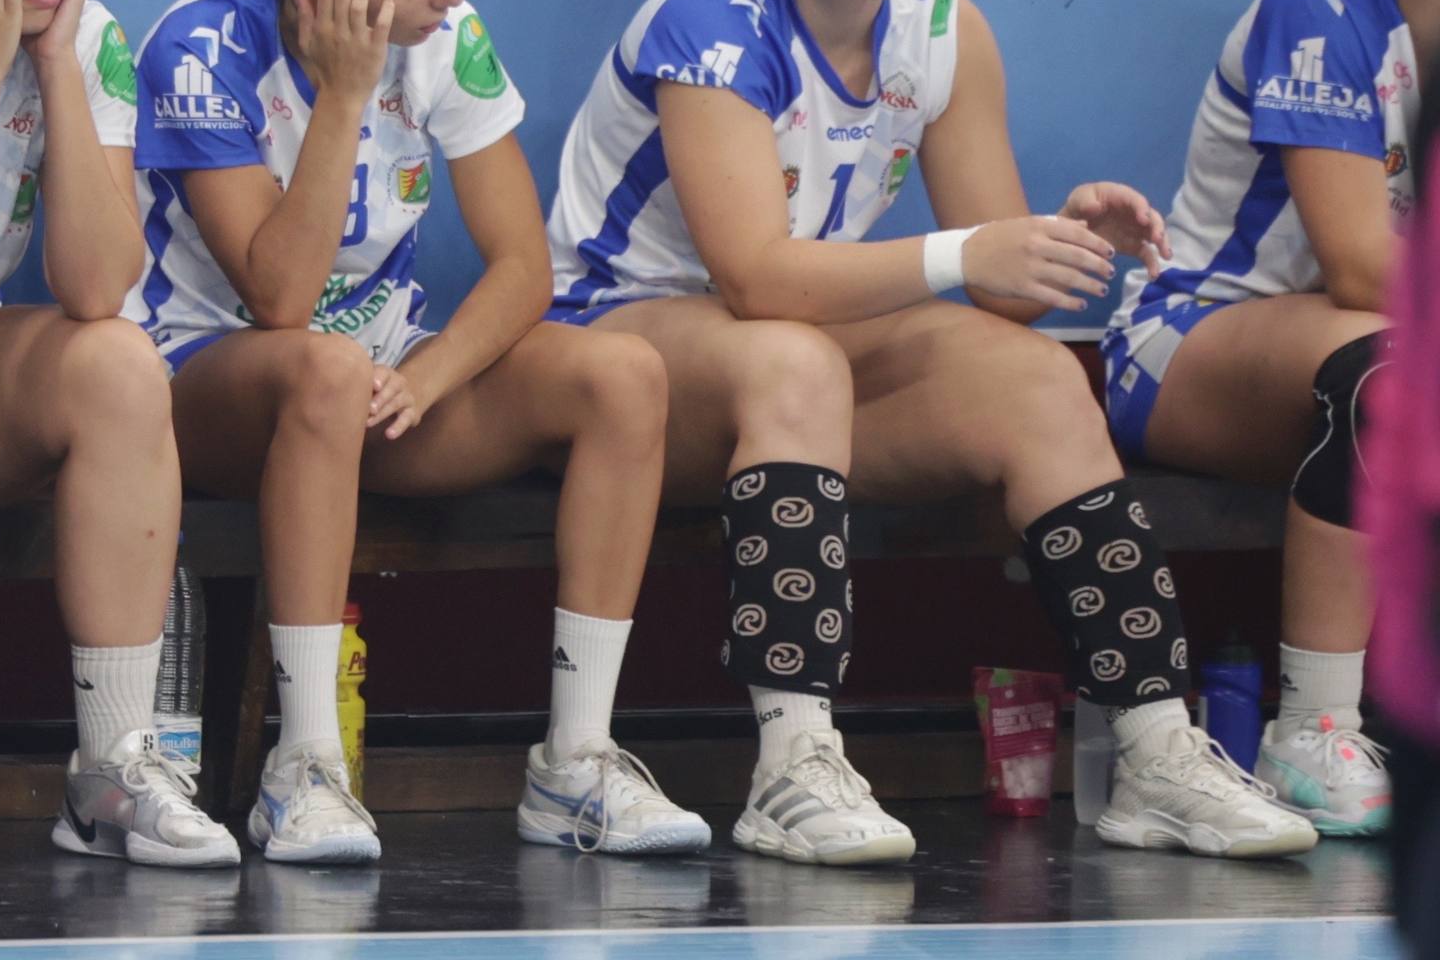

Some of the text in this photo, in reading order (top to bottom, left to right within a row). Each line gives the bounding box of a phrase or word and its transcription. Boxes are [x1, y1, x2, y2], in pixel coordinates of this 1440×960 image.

[154, 96, 246, 119] CALLEJ
[1255, 77, 1374, 115] ALLEJA
[814, 163, 857, 241] 1
